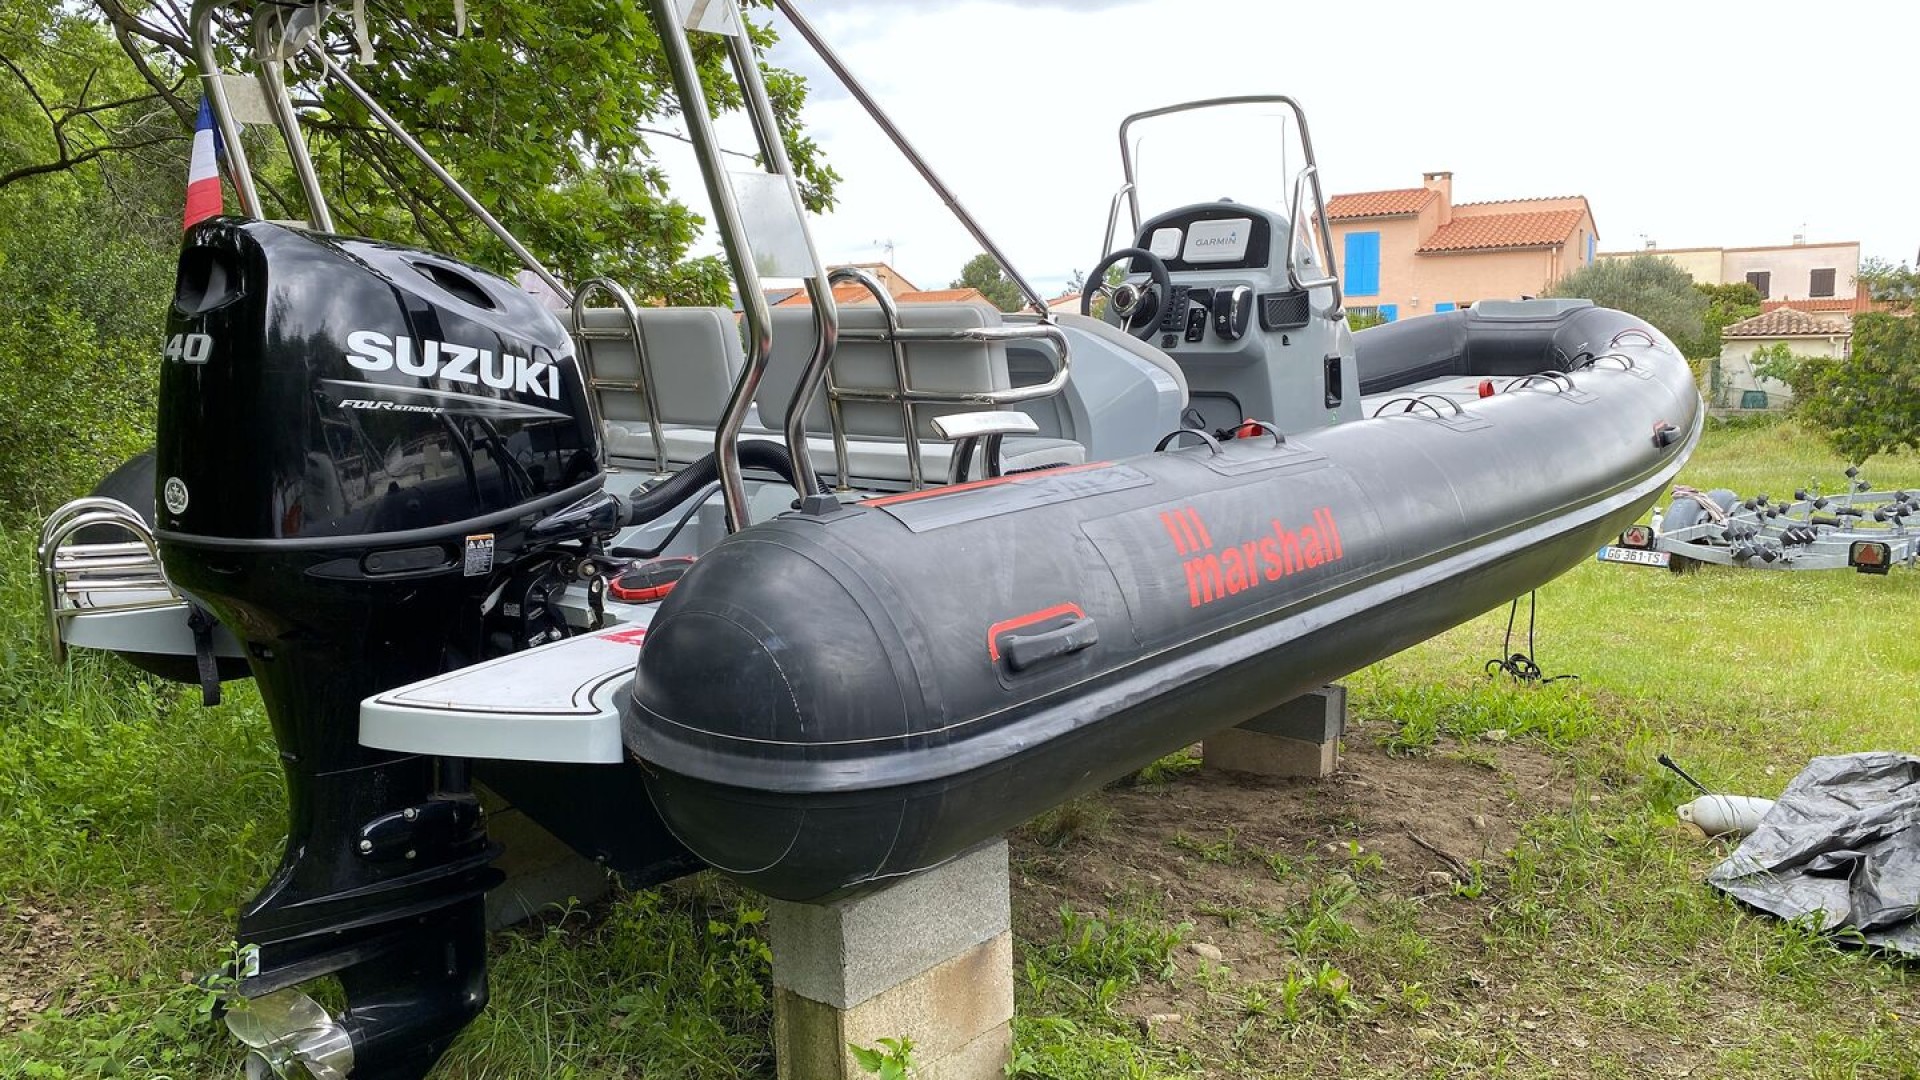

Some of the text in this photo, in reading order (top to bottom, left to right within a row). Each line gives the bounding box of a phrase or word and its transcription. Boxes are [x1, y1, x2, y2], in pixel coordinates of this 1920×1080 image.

[1195, 236, 1237, 247] GARMIN
[346, 330, 560, 400] SUZUKI
[338, 399, 445, 414] FOUR STROKE
[1184, 507, 1343, 608] marshall
